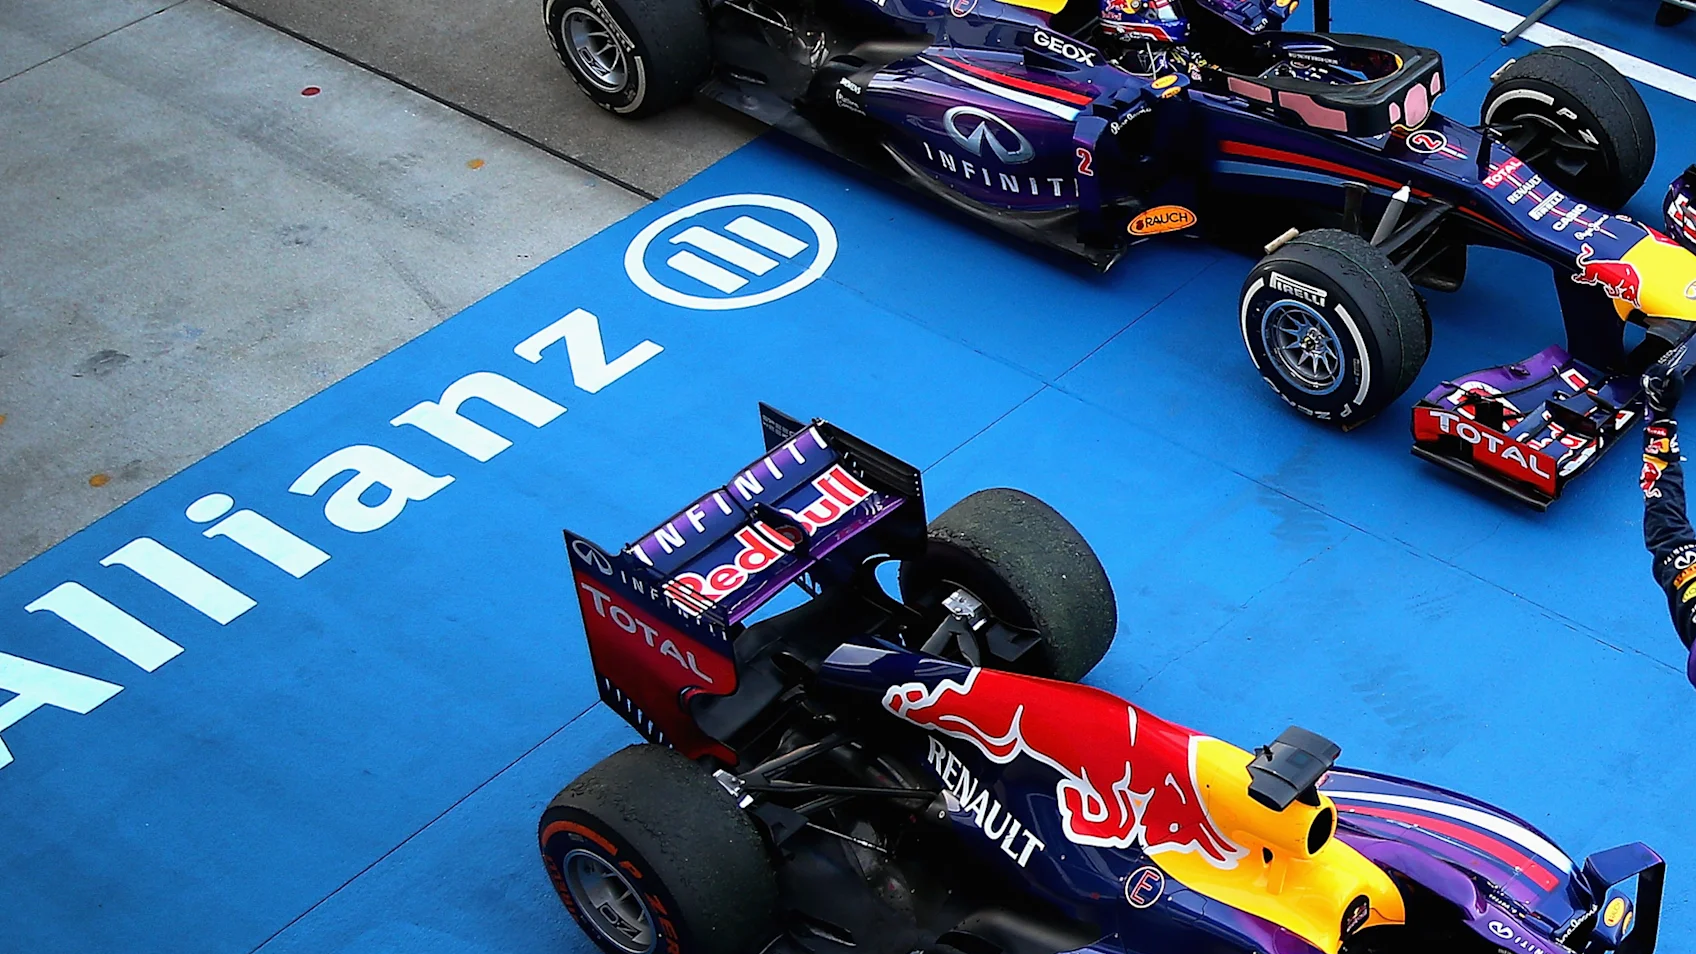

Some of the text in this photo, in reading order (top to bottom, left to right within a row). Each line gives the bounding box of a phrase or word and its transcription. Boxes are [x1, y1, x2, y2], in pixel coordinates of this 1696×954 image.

[1033, 30, 1095, 68] GEOX
[1411, 133, 1443, 151] 2
[922, 141, 1080, 198] INFINITI
[1075, 148, 1094, 177] 2
[1482, 158, 1523, 188] TOTAL
[1506, 173, 1543, 205] RENAULT
[1528, 190, 1566, 222] PIRELLI
[1145, 212, 1188, 228] RAUCH
[1552, 203, 1588, 232] CASIO
[1269, 271, 1328, 307] PIRELLI
[1429, 410, 1551, 481] TOTAL
[629, 426, 828, 567] INFINITI
[0, 307, 663, 775] Allianz
[580, 582, 713, 684] TOTAL
[928, 735, 1045, 868] RENAULT
[1130, 870, 1160, 905] E
